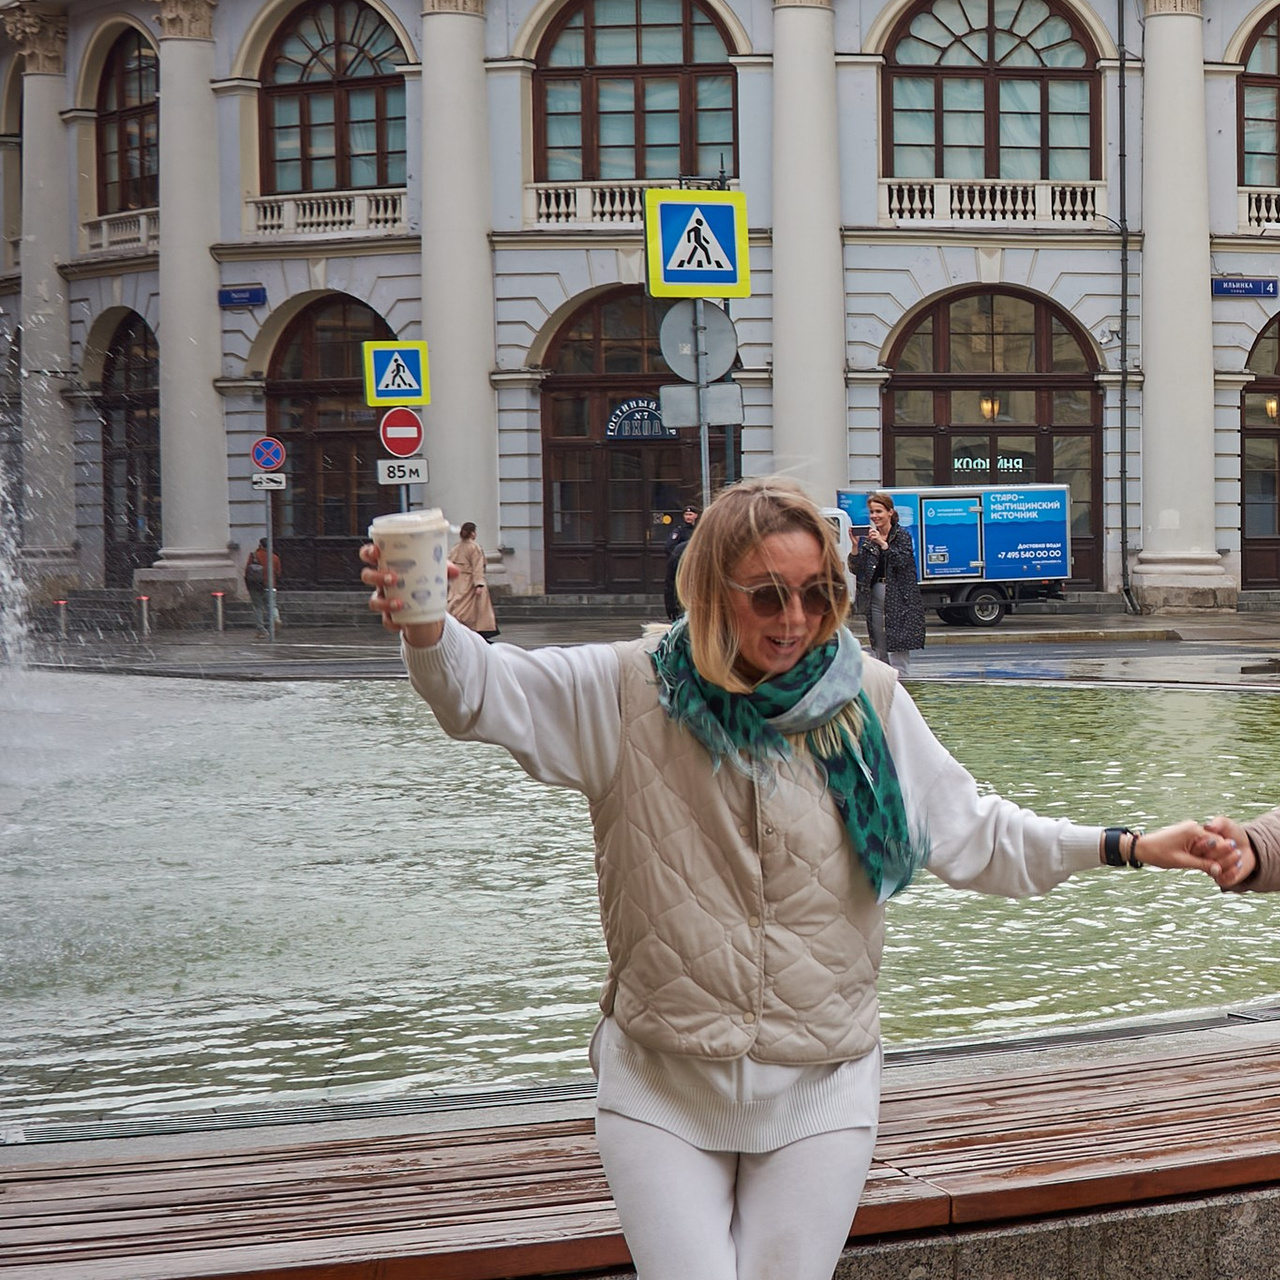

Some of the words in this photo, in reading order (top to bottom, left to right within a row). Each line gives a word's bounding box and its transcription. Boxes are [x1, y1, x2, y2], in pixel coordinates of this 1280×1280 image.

[1266, 282, 1274, 293] 4
[606, 399, 657, 436] ГОСТИНЫЙ
[622, 420, 662, 436] ВХОД
[387, 464, 407, 479] 85
[990, 500, 1061, 511] МЫТИЩИНСКИЙ
[990, 511, 1039, 520] ИСТОЧНИК
[1006, 551, 1020, 559] 495
[1020, 550, 1035, 558] 540
[1036, 550, 1048, 558] 00
[1049, 549, 1062, 558] 00
